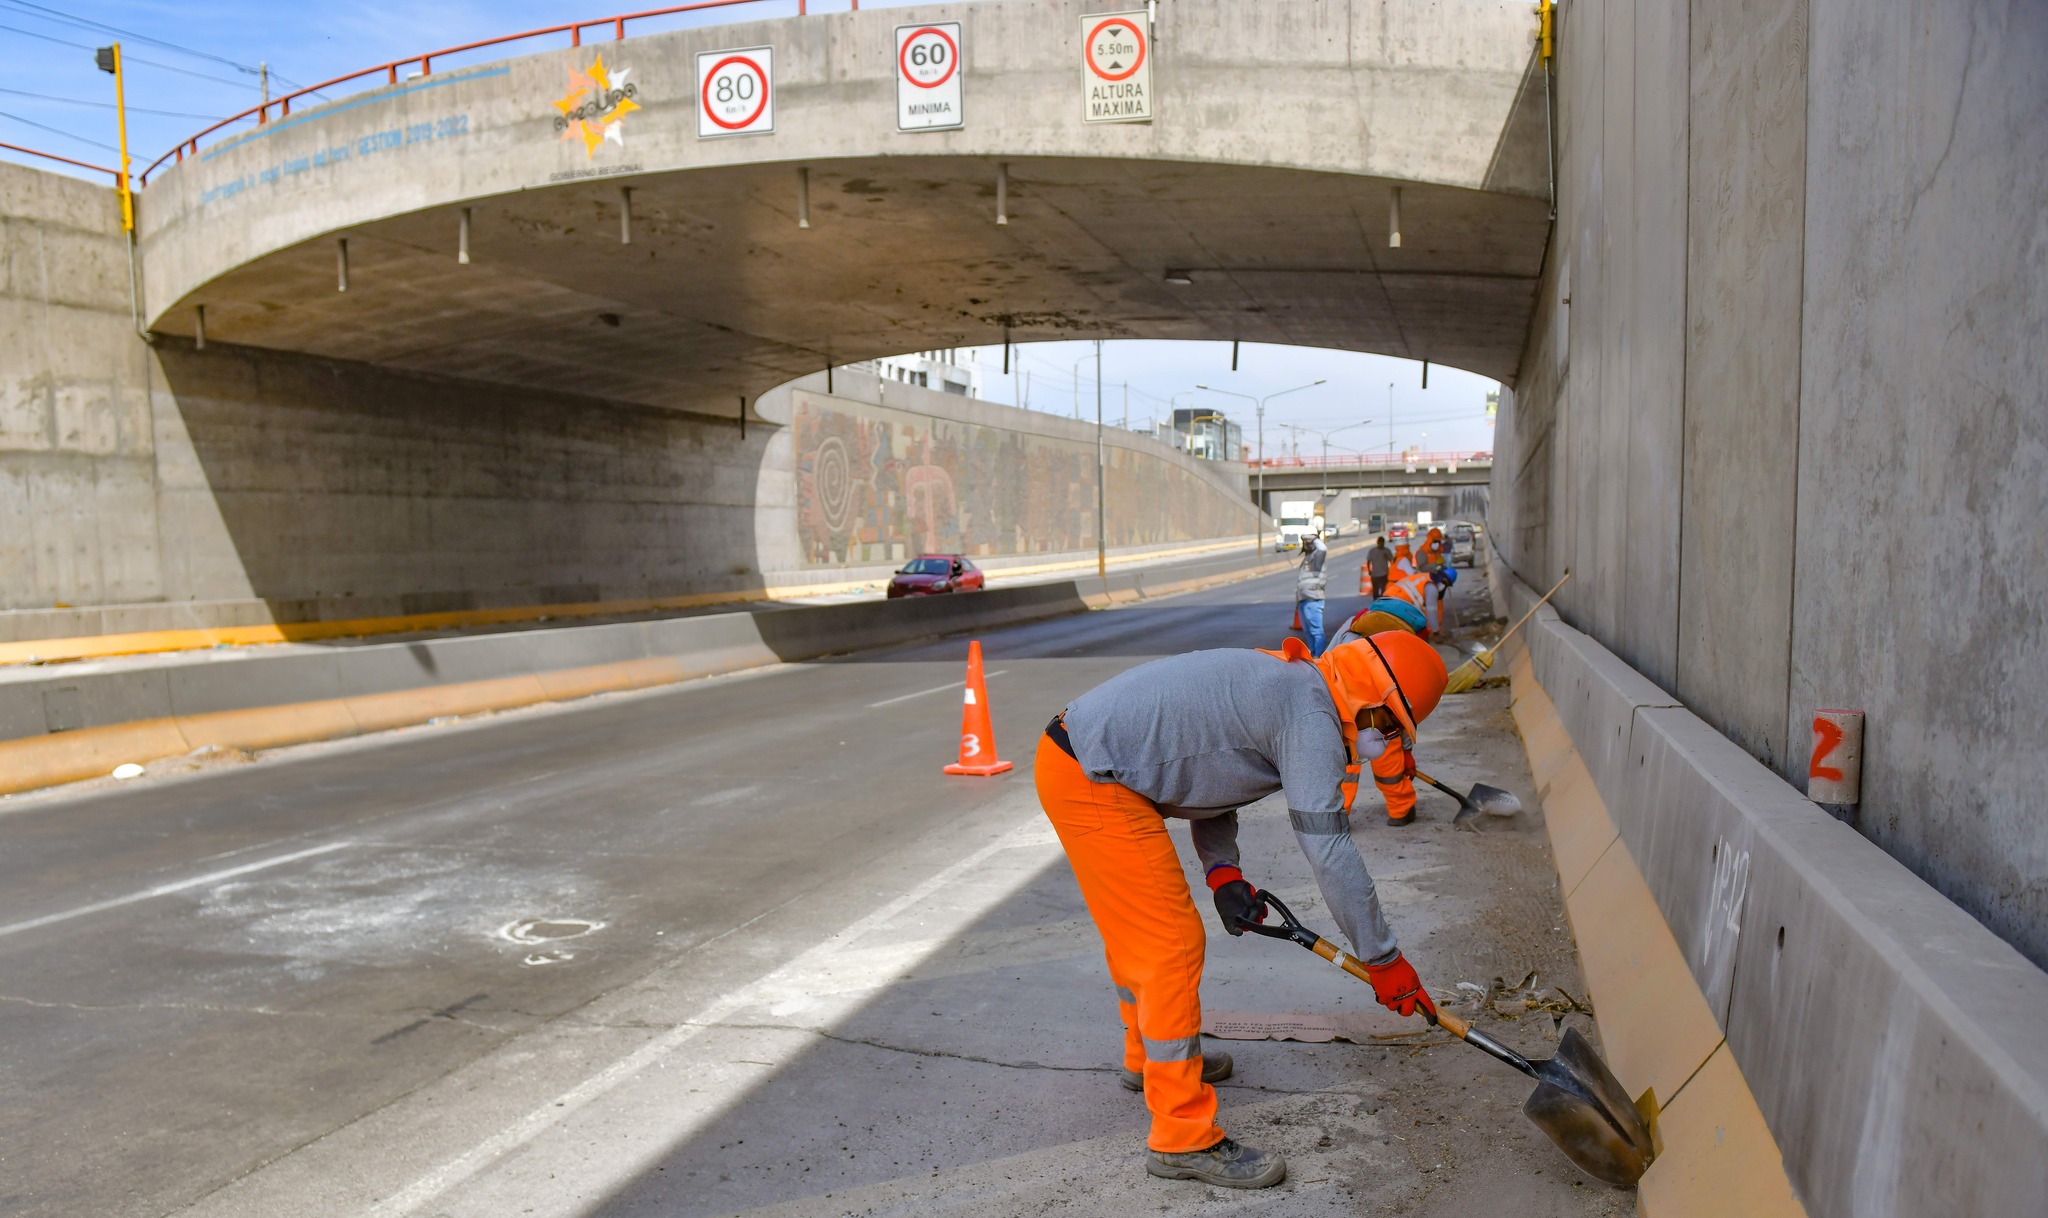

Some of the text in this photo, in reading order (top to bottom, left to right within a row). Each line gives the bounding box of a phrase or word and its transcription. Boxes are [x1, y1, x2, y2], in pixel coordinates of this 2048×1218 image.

[911, 43, 945, 66] 60
[1097, 43, 1134, 56] 5.50m
[716, 73, 754, 102] 80
[1092, 83, 1144, 100] ALTURA
[908, 102, 951, 115] MINIMA
[1092, 100, 1144, 117] MAXIMA
[962, 733, 981, 757] 3
[1809, 717, 1844, 782] 2
